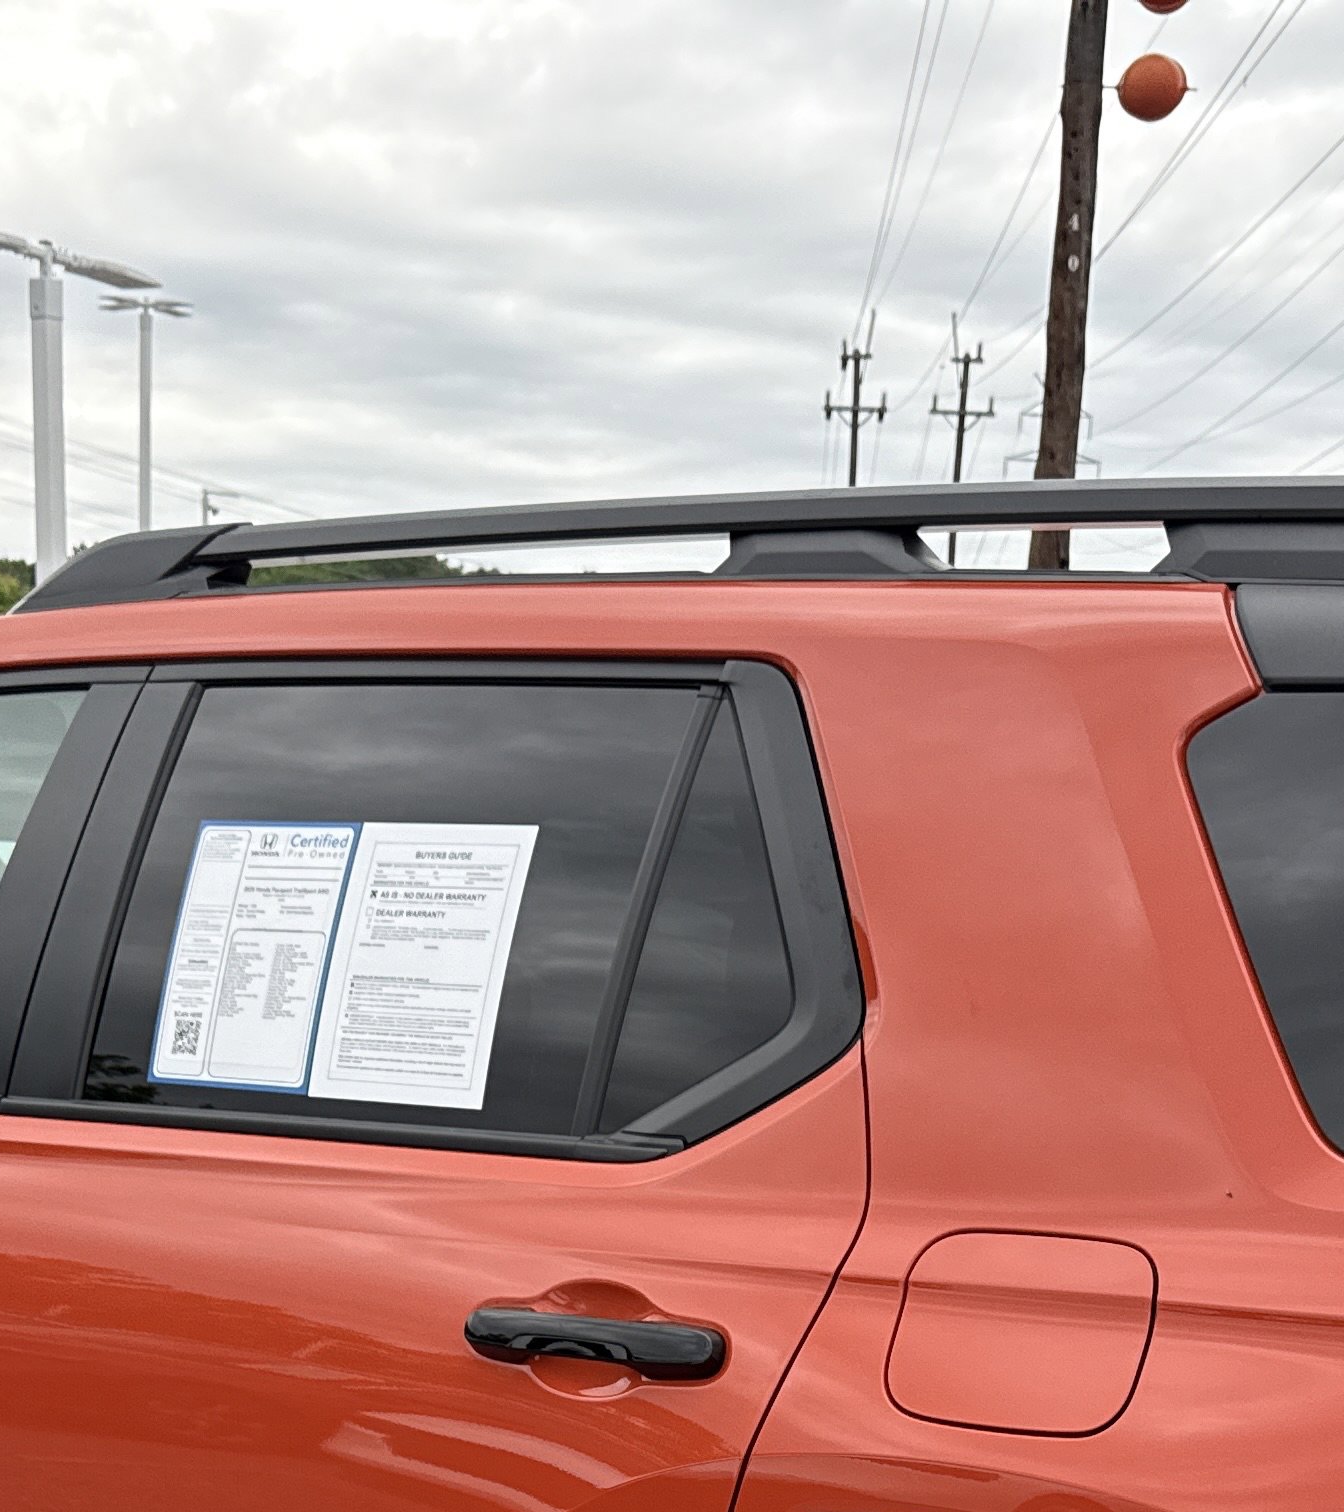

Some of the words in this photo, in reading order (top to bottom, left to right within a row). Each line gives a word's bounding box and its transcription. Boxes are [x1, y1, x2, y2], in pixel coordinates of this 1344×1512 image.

[290, 833, 351, 848] Certified
[415, 851, 447, 860] BUYERS
[448, 851, 473, 860] GUIDE
[380, 890, 390, 899] AS
[391, 890, 398, 899] IS
[404, 891, 414, 899] NO
[415, 891, 444, 900] DEALER
[445, 892, 487, 902] WARRANTY
[376, 908, 404, 917] DEALER
[405, 909, 446, 919] WARRANTY
